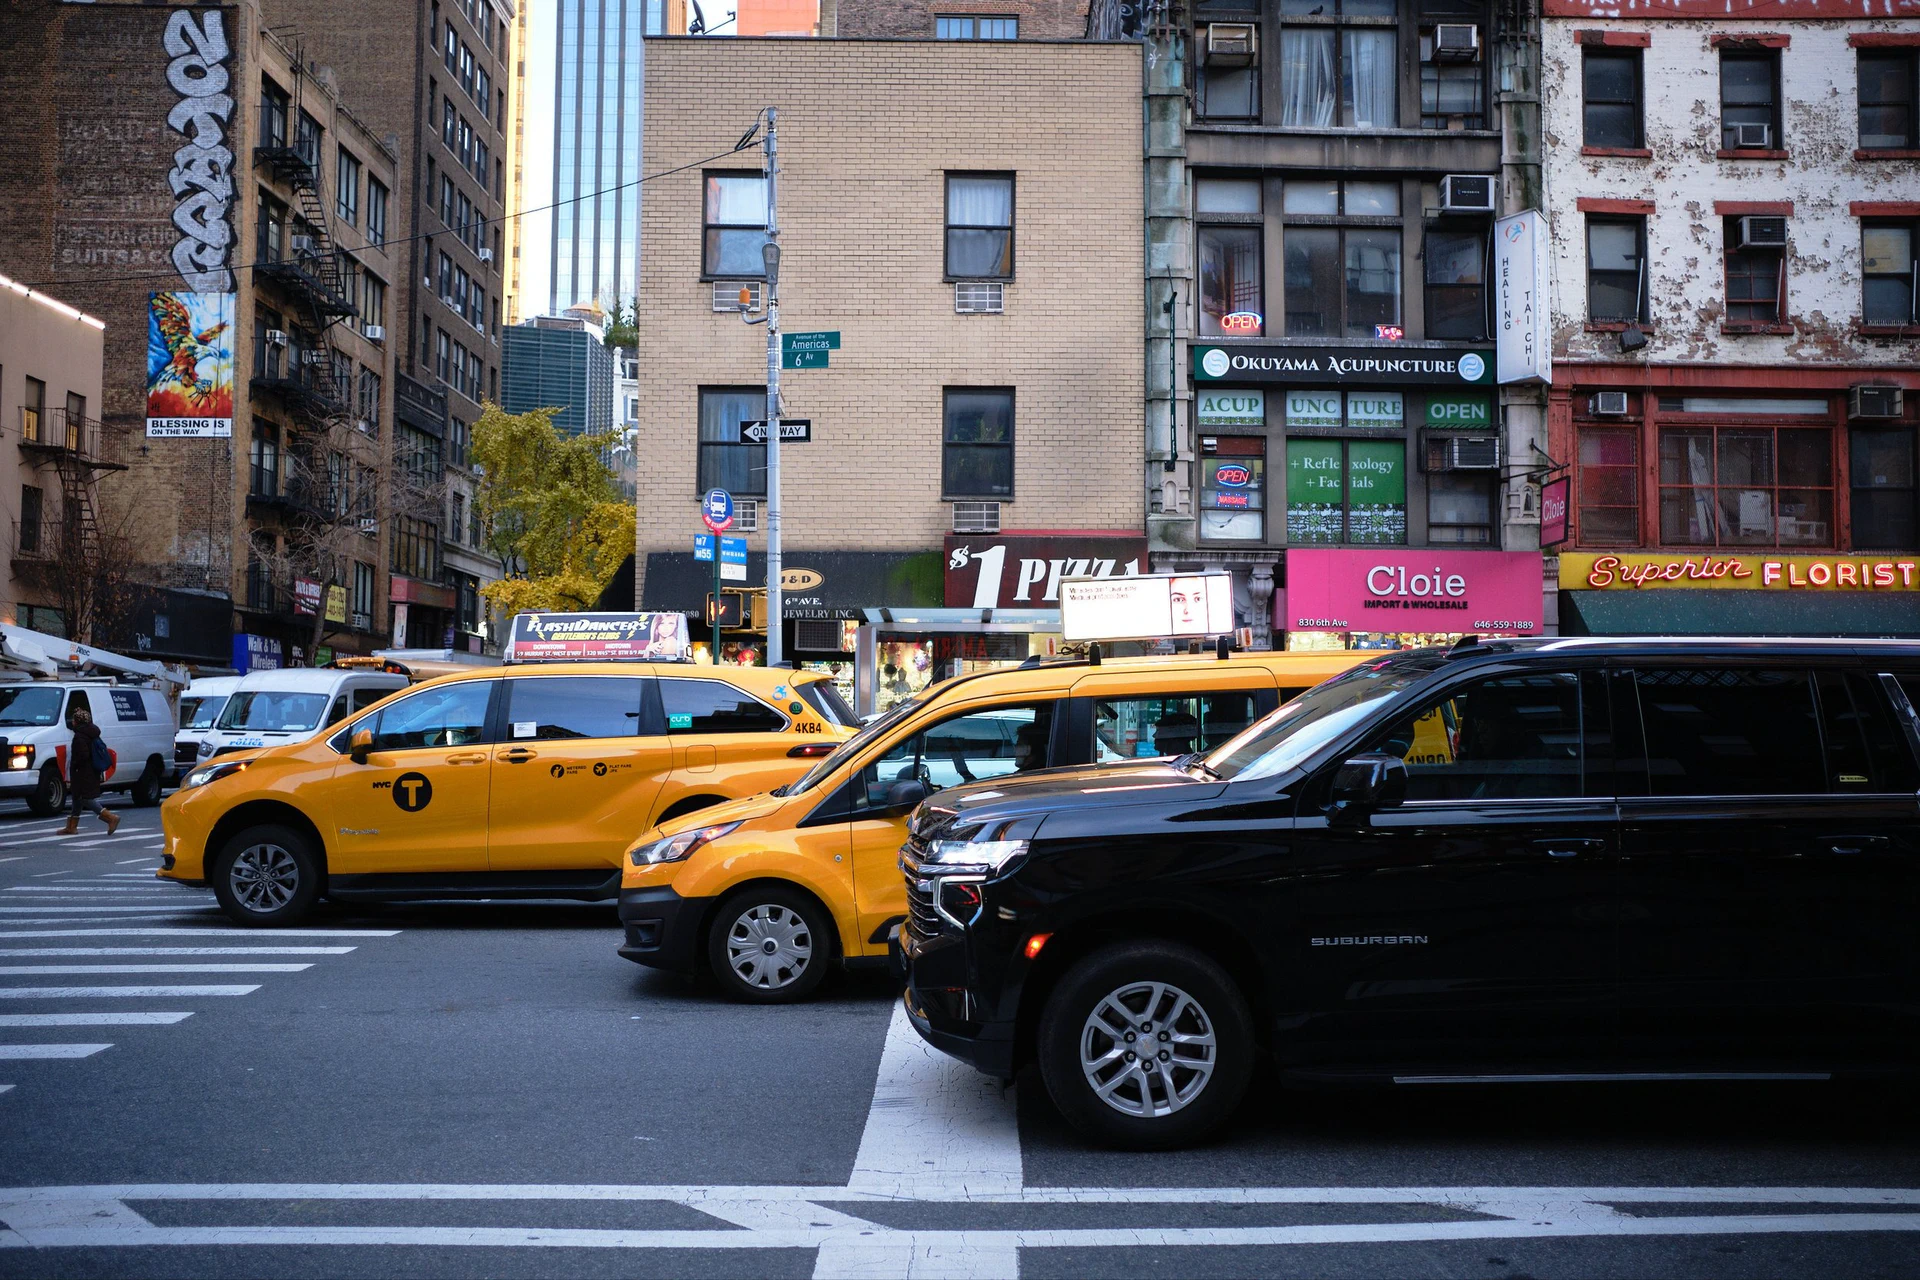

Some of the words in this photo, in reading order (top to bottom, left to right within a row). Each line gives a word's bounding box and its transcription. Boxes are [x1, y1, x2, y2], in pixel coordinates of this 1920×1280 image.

[1502, 257, 1512, 331] HEALING
[1524, 291, 1532, 325] TAI
[1222, 315, 1260, 329] OPEN
[791, 340, 830, 350] Americas
[1524, 332, 1532, 366] CHI
[795, 353, 802, 367] 6
[805, 352, 814, 361] Av
[1430, 403, 1485, 419] OPEN
[151, 420, 209, 428] BLESSING
[213, 420, 225, 428] IS
[752, 427, 767, 437] ON
[779, 427, 802, 436] WAY
[1217, 470, 1250, 482] OPEN
[1218, 496, 1247, 504] MASSAGE
[1543, 497, 1565, 521] Cloie
[695, 537, 707, 546] M7
[695, 549, 712, 559] M55
[1588, 556, 1753, 589] Superior
[789, 575, 798, 584] &
[801, 575, 811, 583] D
[1367, 566, 1466, 597] Cloie
[1364, 600, 1401, 609] IMPORT
[1403, 600, 1410, 609] &
[1411, 600, 1468, 610] WHOLESALE
[783, 609, 830, 619] JEWELRY
[834, 609, 855, 619] INC.
[1298, 618, 1315, 627] 830
[1315, 618, 1330, 627] 6th
[1331, 618, 1348, 627] Ave
[1474, 620, 1534, 629] 646-559-1889
[247, 636, 263, 652] Walk
[263, 639, 269, 652] &
[270, 639, 282, 654] Talk
[252, 653, 278, 670] Wireless
[795, 722, 822, 734] 4K84
[1311, 936, 1428, 946] SUBURBAN
